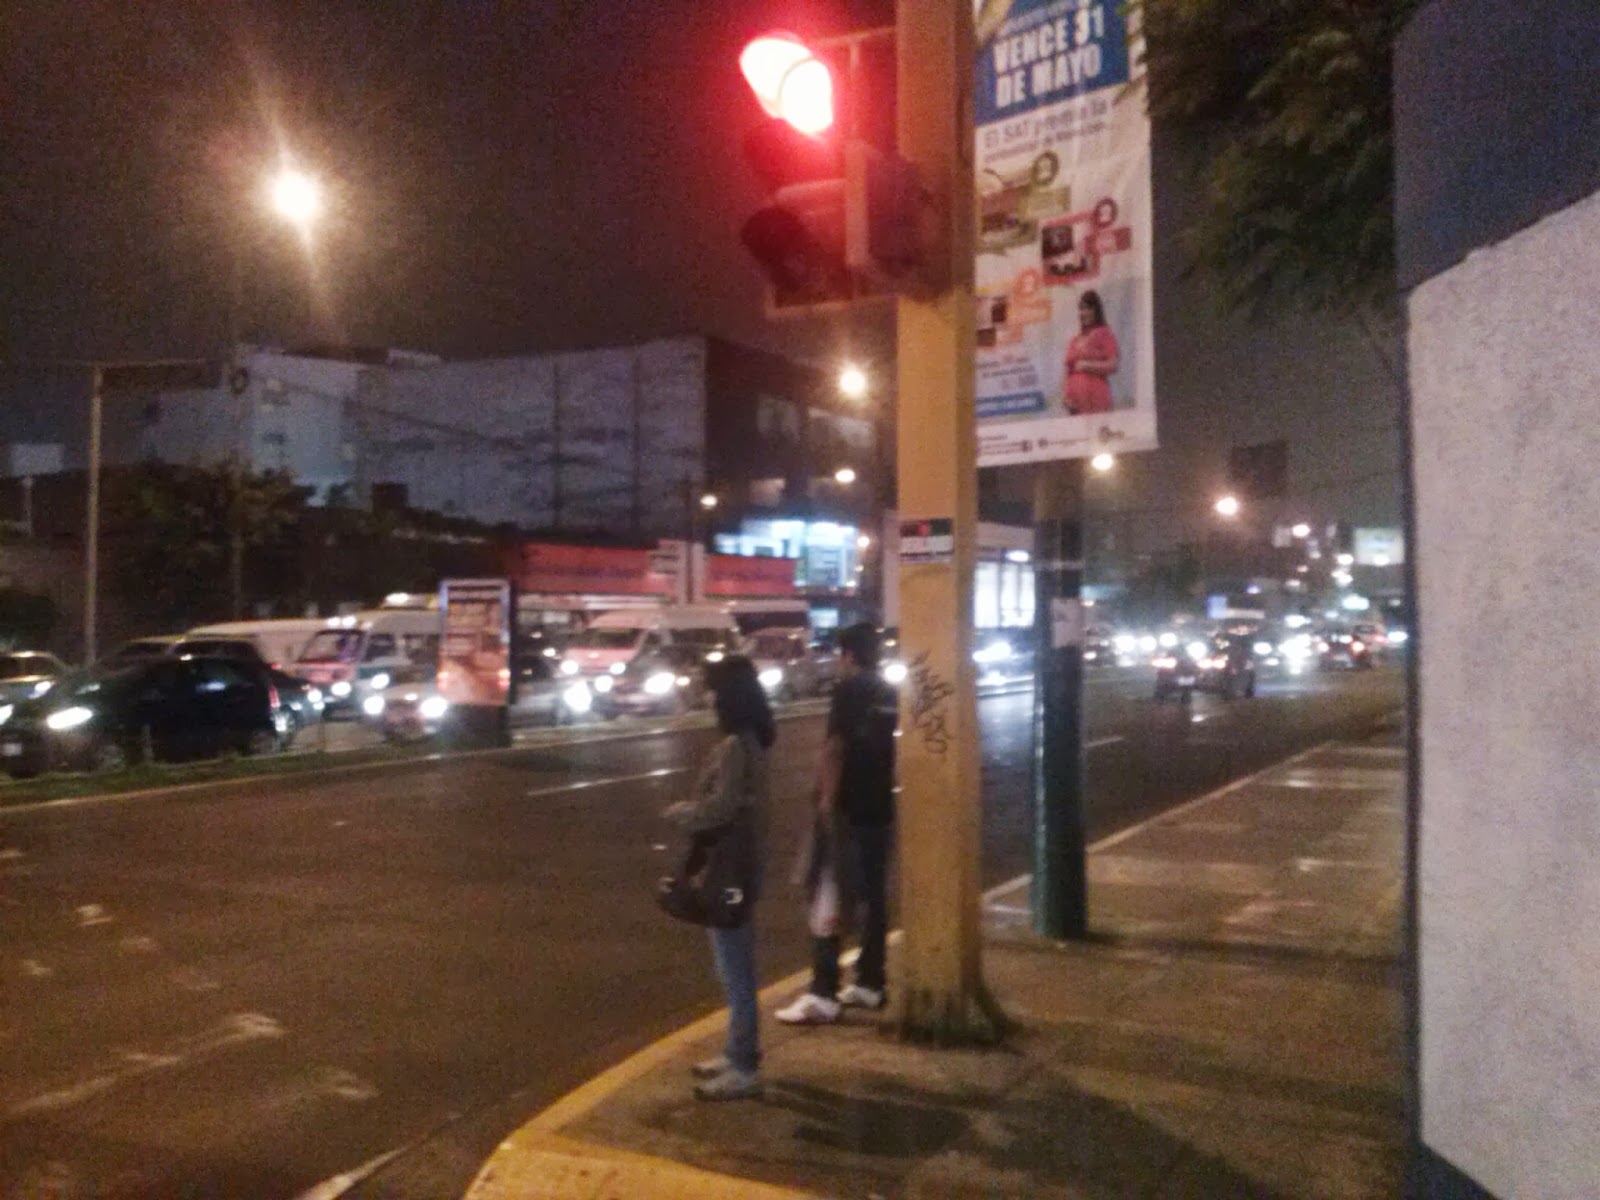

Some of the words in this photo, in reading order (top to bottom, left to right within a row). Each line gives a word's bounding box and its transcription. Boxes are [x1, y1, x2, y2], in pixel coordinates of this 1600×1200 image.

[994, 18, 1068, 73] VENCE
[1075, 4, 1104, 45] 31
[996, 70, 1026, 108] DE
[1032, 43, 1101, 95] MAYO
